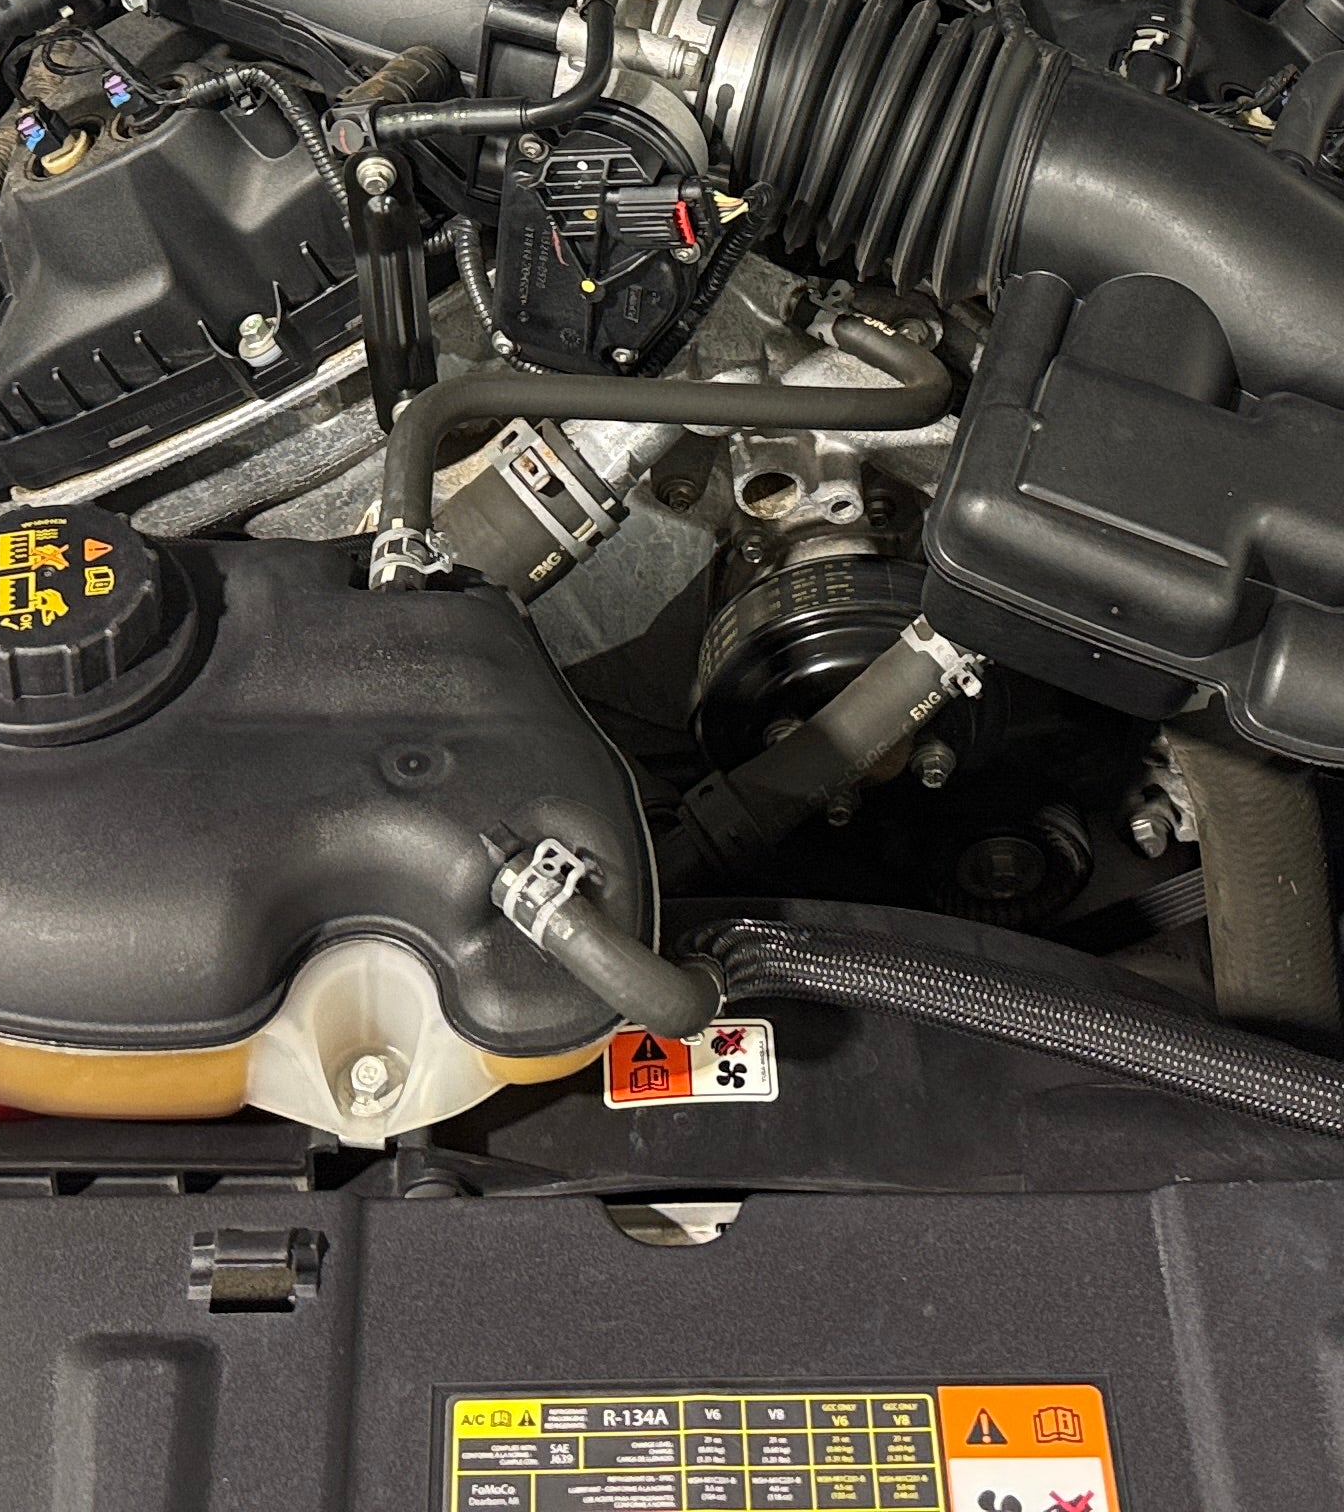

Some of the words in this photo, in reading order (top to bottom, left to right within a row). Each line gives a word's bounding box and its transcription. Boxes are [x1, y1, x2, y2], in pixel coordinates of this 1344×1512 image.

[528, 551, 562, 582] ENG
[19, 614, 33, 632] OK
[910, 691, 943, 723] ENG
[460, 1414, 486, 1426] A/C
[602, 1408, 670, 1427] R-134A
[704, 1408, 722, 1421] V6
[767, 1408, 786, 1421] V8
[831, 1414, 849, 1427] V6
[892, 1414, 911, 1426] V8
[549, 1443, 570, 1454] SAE
[471, 1483, 516, 1496] FoMoCo
